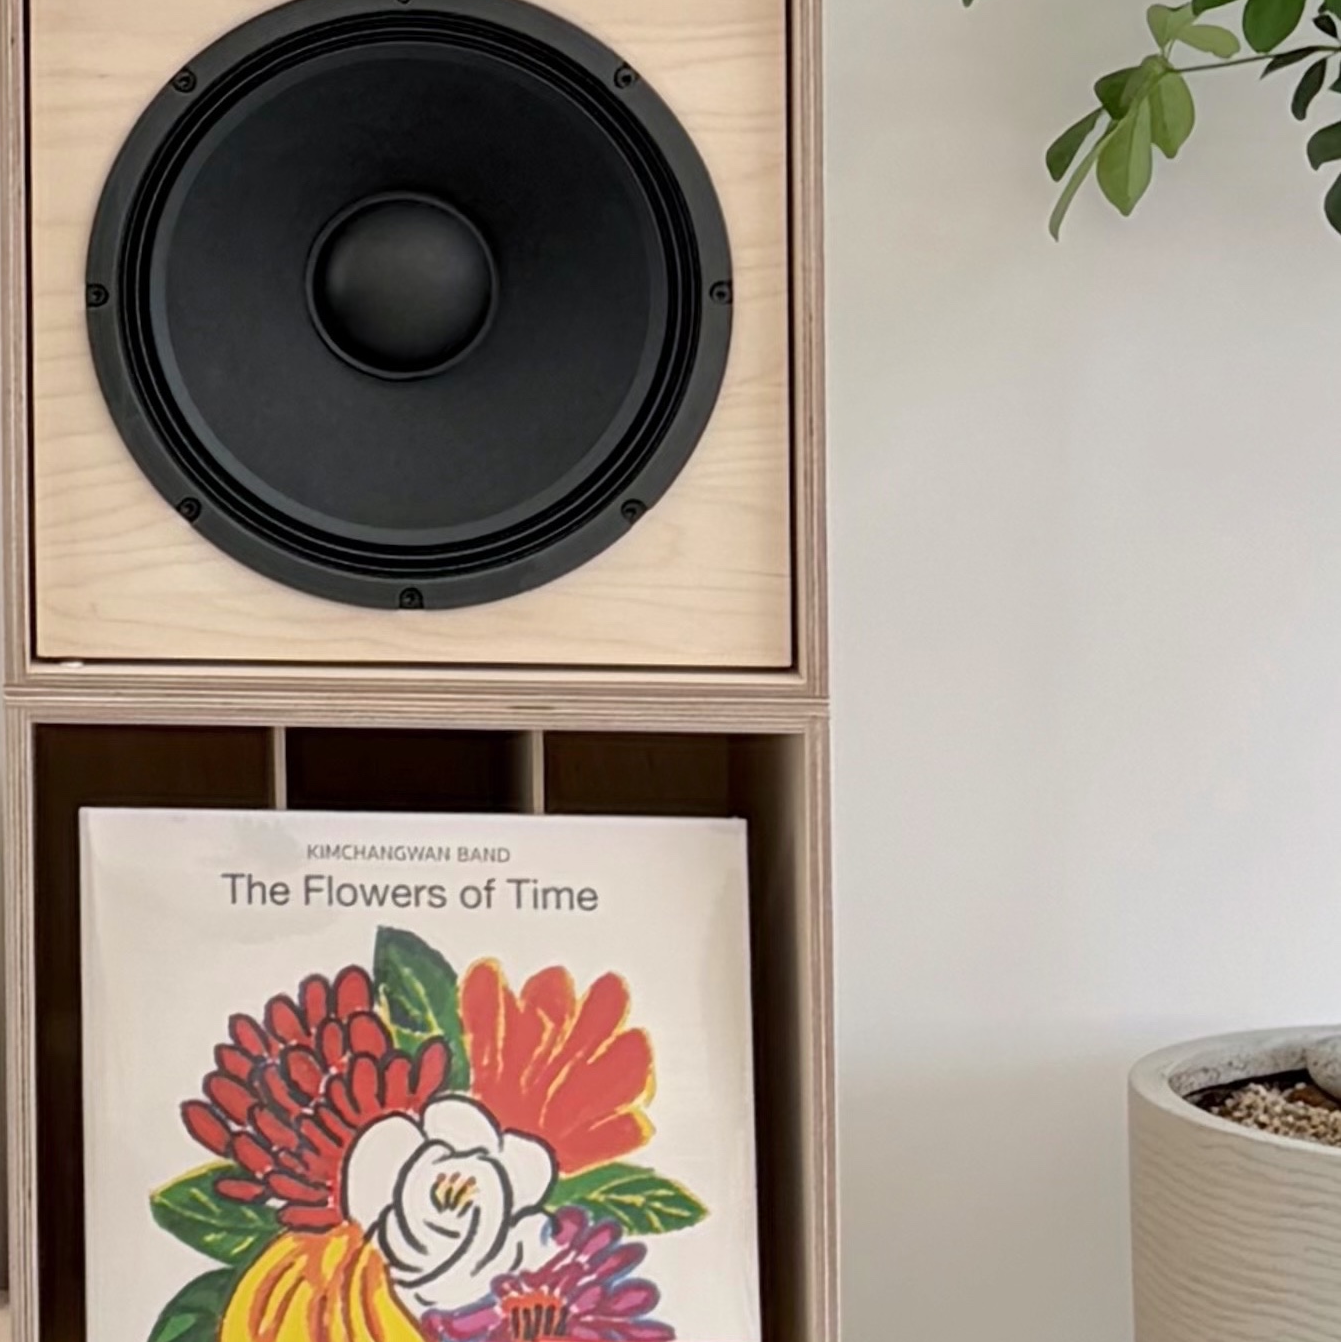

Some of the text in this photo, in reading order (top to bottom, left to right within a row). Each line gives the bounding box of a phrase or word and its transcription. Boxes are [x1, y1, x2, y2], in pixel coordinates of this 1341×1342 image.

[306, 843, 511, 864] KIMCHANGWAN BAND
[221, 872, 599, 912] The Flowers of Time
